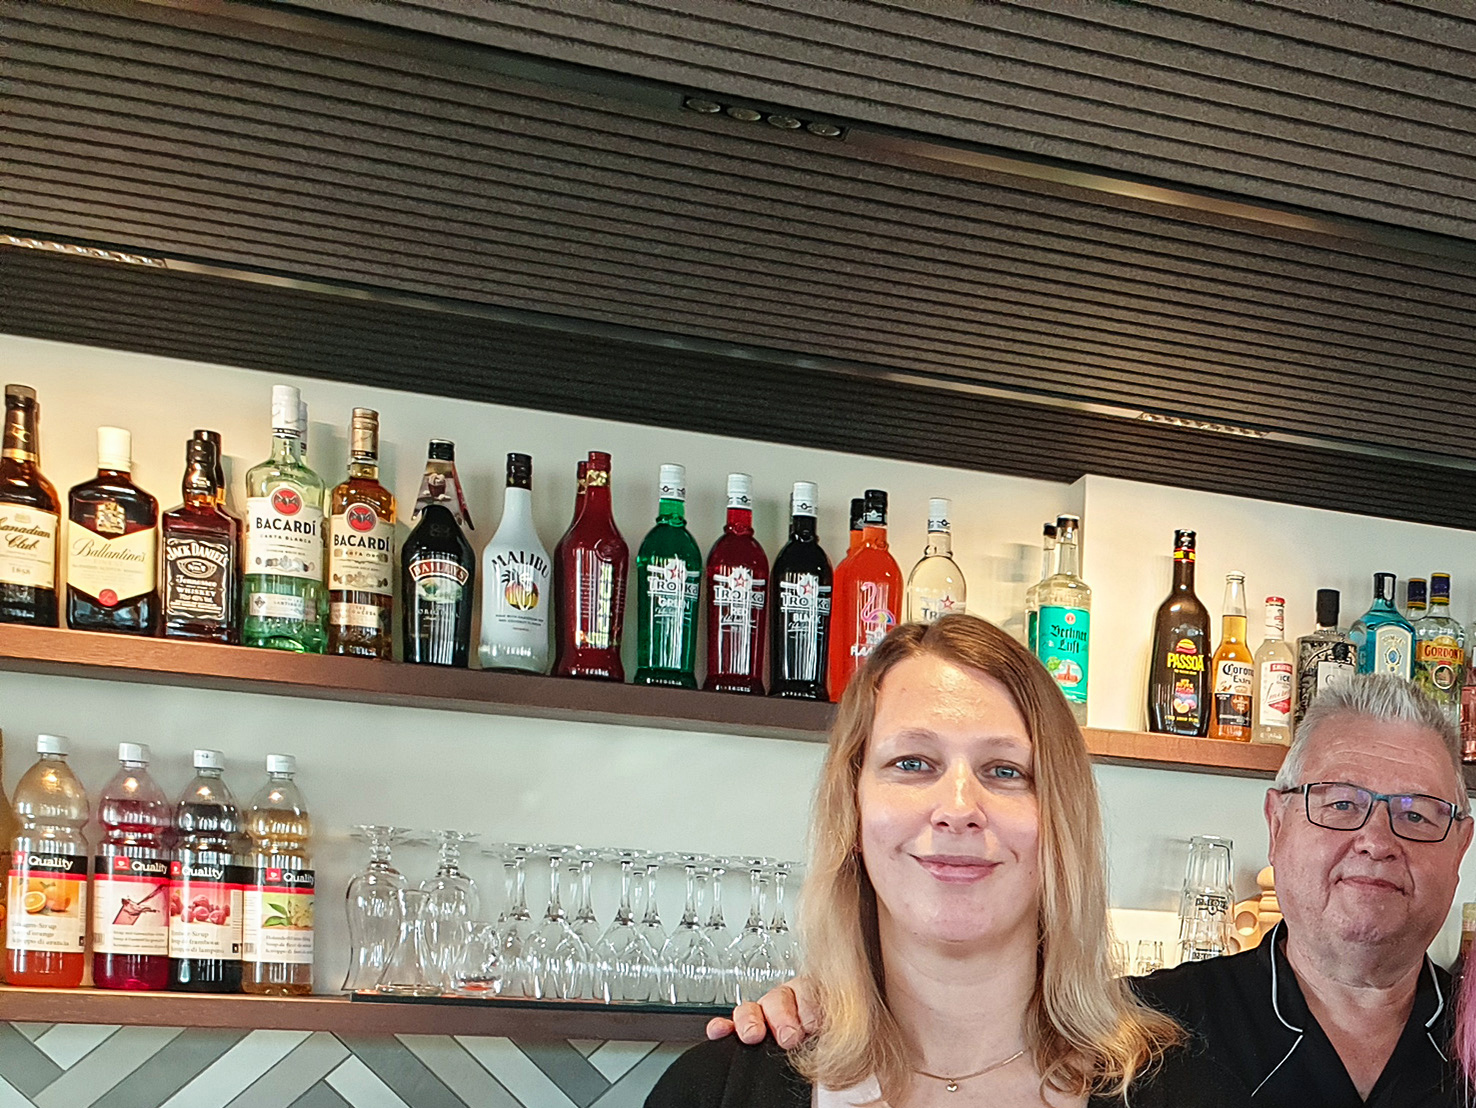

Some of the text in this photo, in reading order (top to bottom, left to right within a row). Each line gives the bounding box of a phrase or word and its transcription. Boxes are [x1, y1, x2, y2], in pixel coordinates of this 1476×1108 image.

[256, 517, 316, 536] BACARDÍ
[5, 533, 39, 550] Club
[333, 534, 390, 552] BACARDÍ
[73, 538, 146, 562] Ballantine's
[166, 545, 191, 561] JACK
[491, 550, 550, 579] MALIBU
[28, 856, 73, 871] Quality
[132, 859, 168, 875] Quality
[182, 864, 223, 880] Quality
[283, 871, 314, 886] Quality
